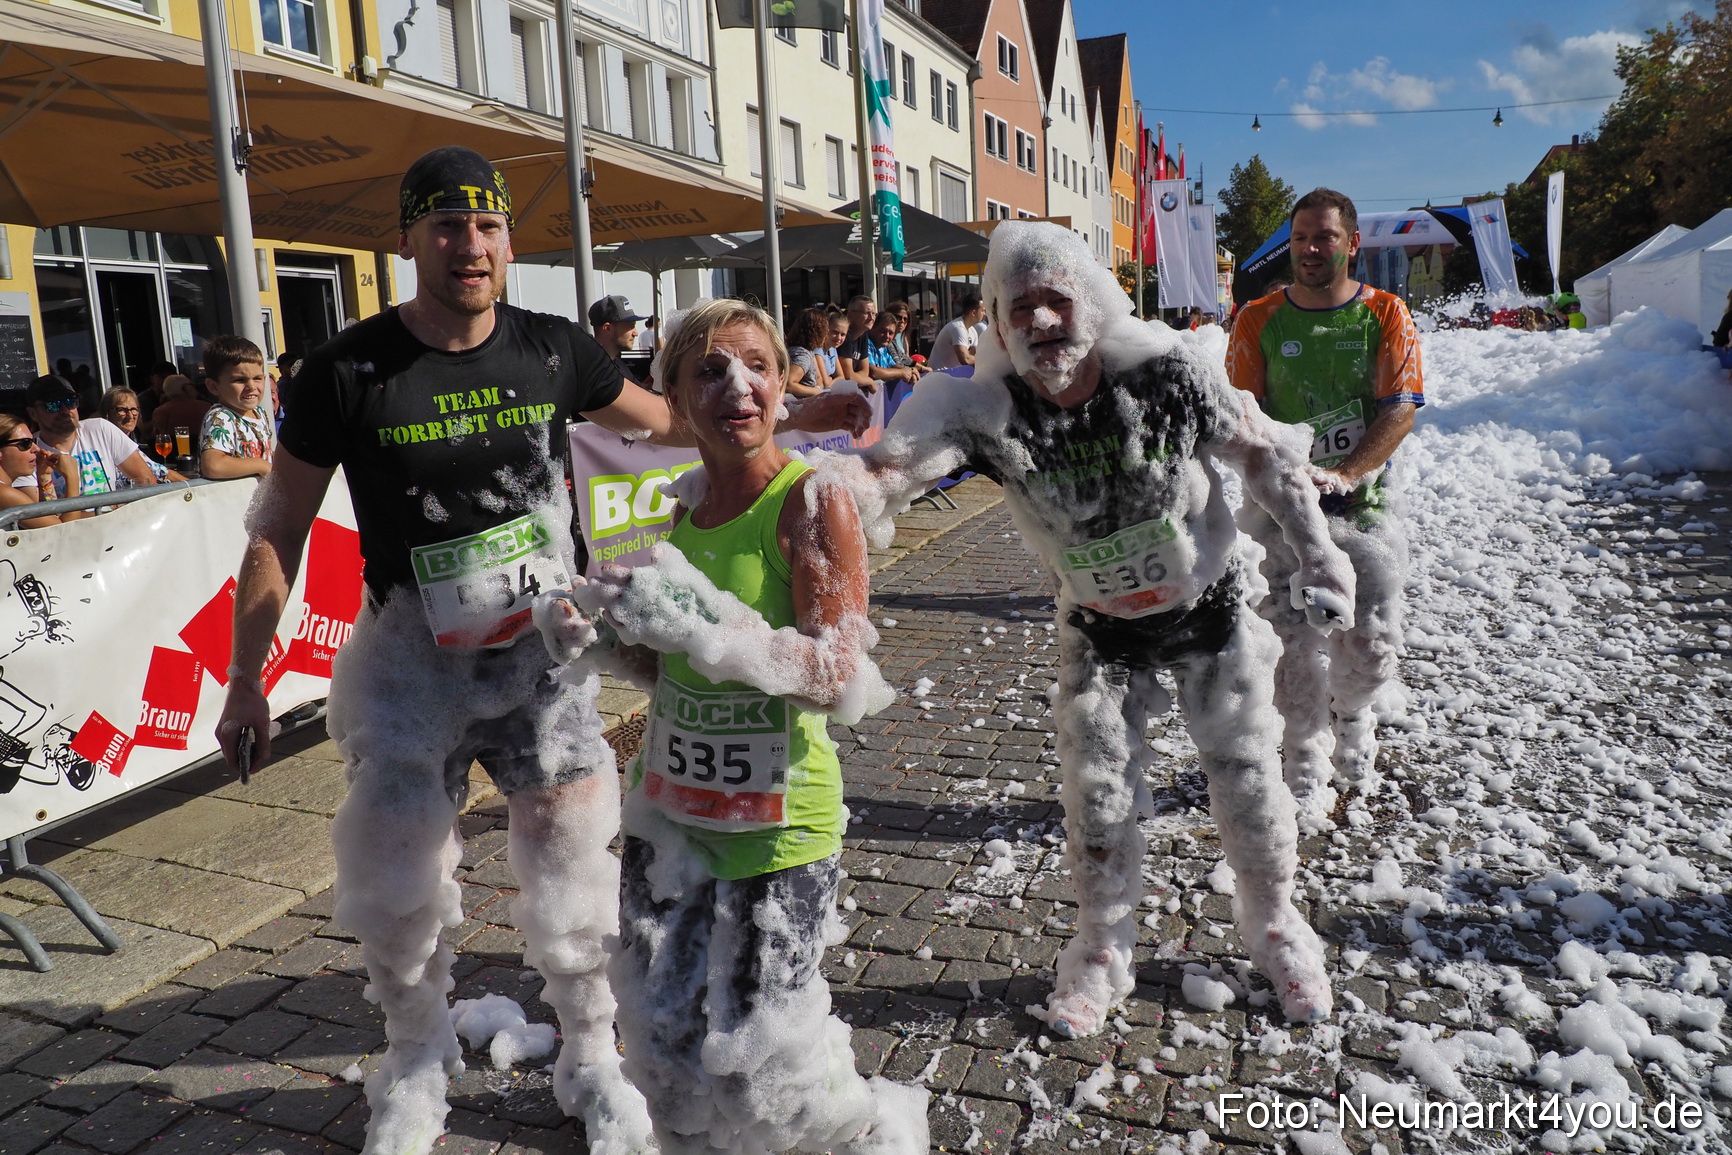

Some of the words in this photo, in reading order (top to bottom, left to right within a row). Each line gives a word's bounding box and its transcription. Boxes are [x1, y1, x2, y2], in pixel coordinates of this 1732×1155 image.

[1248, 258, 1267, 274] PARTL
[1266, 243, 1291, 261] NEUMAR
[360, 272, 374, 287] 24
[433, 387, 502, 414] TEAM
[377, 413, 490, 447] FORREST
[496, 403, 557, 429] GUMP
[1065, 434, 1122, 461] TEAM
[424, 522, 542, 577] BOCK
[592, 533, 641, 563] inspired
[1092, 553, 1168, 594] 536
[140, 700, 190, 731] Braun
[660, 692, 774, 729] OCK
[97, 733, 125, 773] Braun
[668, 734, 751, 786] 535
